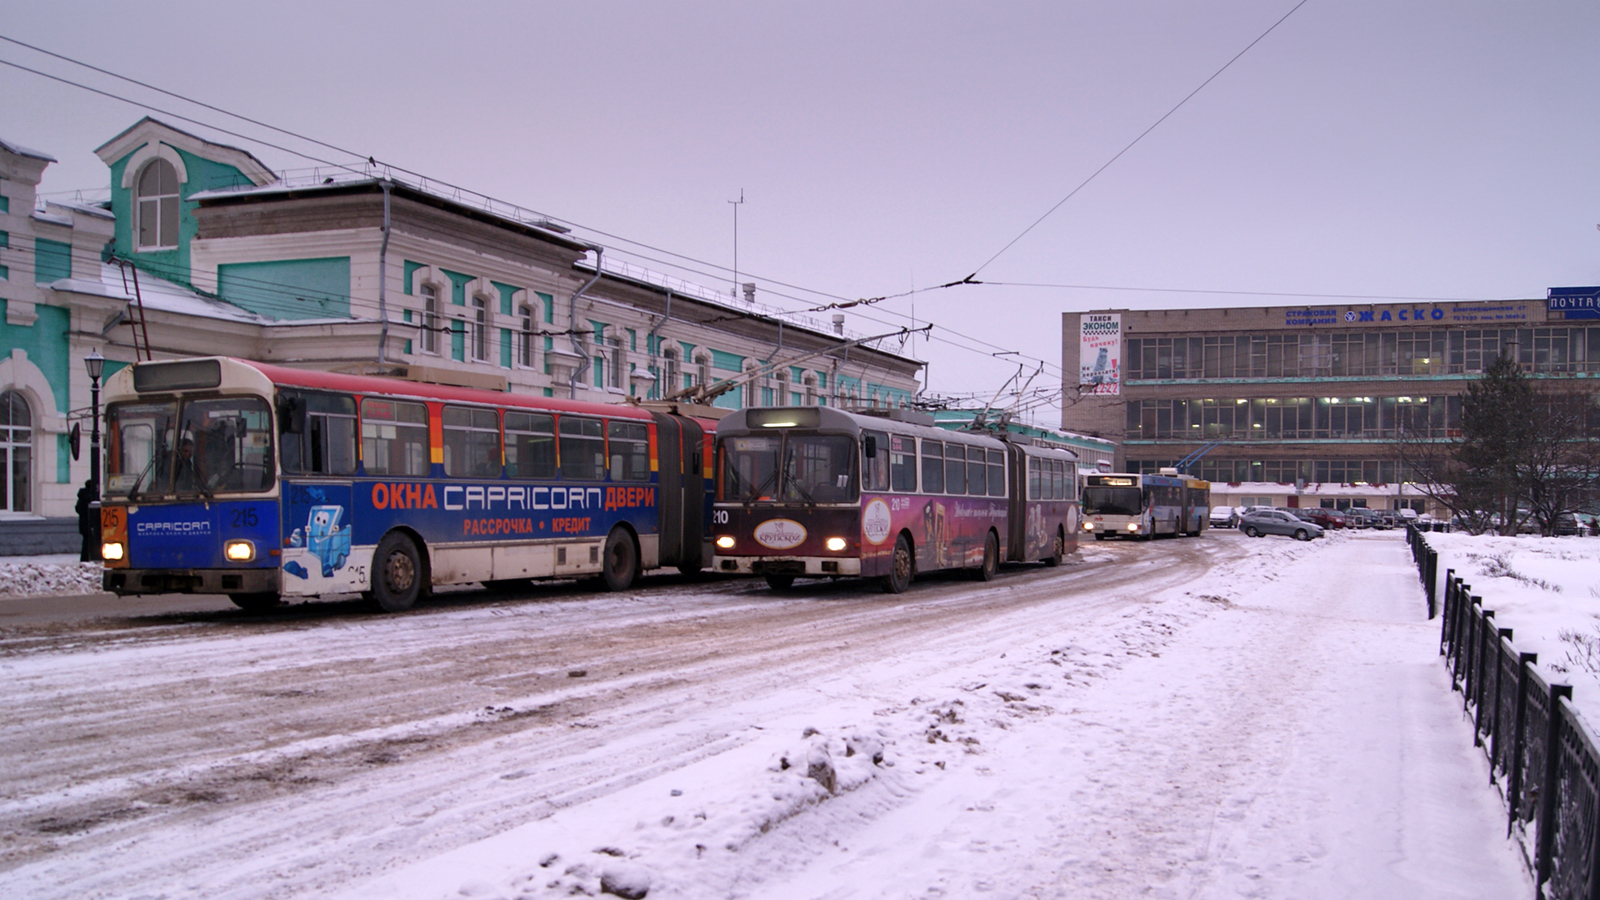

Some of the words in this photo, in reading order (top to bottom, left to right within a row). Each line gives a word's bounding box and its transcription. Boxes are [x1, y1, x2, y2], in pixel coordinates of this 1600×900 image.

[1551, 297, 1593, 307] ПОЧТА
[1286, 309, 1337, 317] СТРАХОВАЯ
[1358, 308, 1444, 322] ЖАСКО
[1083, 322, 1119, 330] ЭКОНОМ
[1286, 317, 1337, 325] КОМПАНИЯ
[371, 483, 438, 510] ОКНА
[444, 486, 602, 510] CAPRICORN
[604, 486, 655, 512] ДВЕРИ
[102, 508, 119, 527] 215
[231, 508, 258, 528] 215
[136, 521, 210, 531] CAPRICORN
[464, 518, 533, 535] РАССРОЧКА
[552, 517, 591, 534] КРЕДИТ
